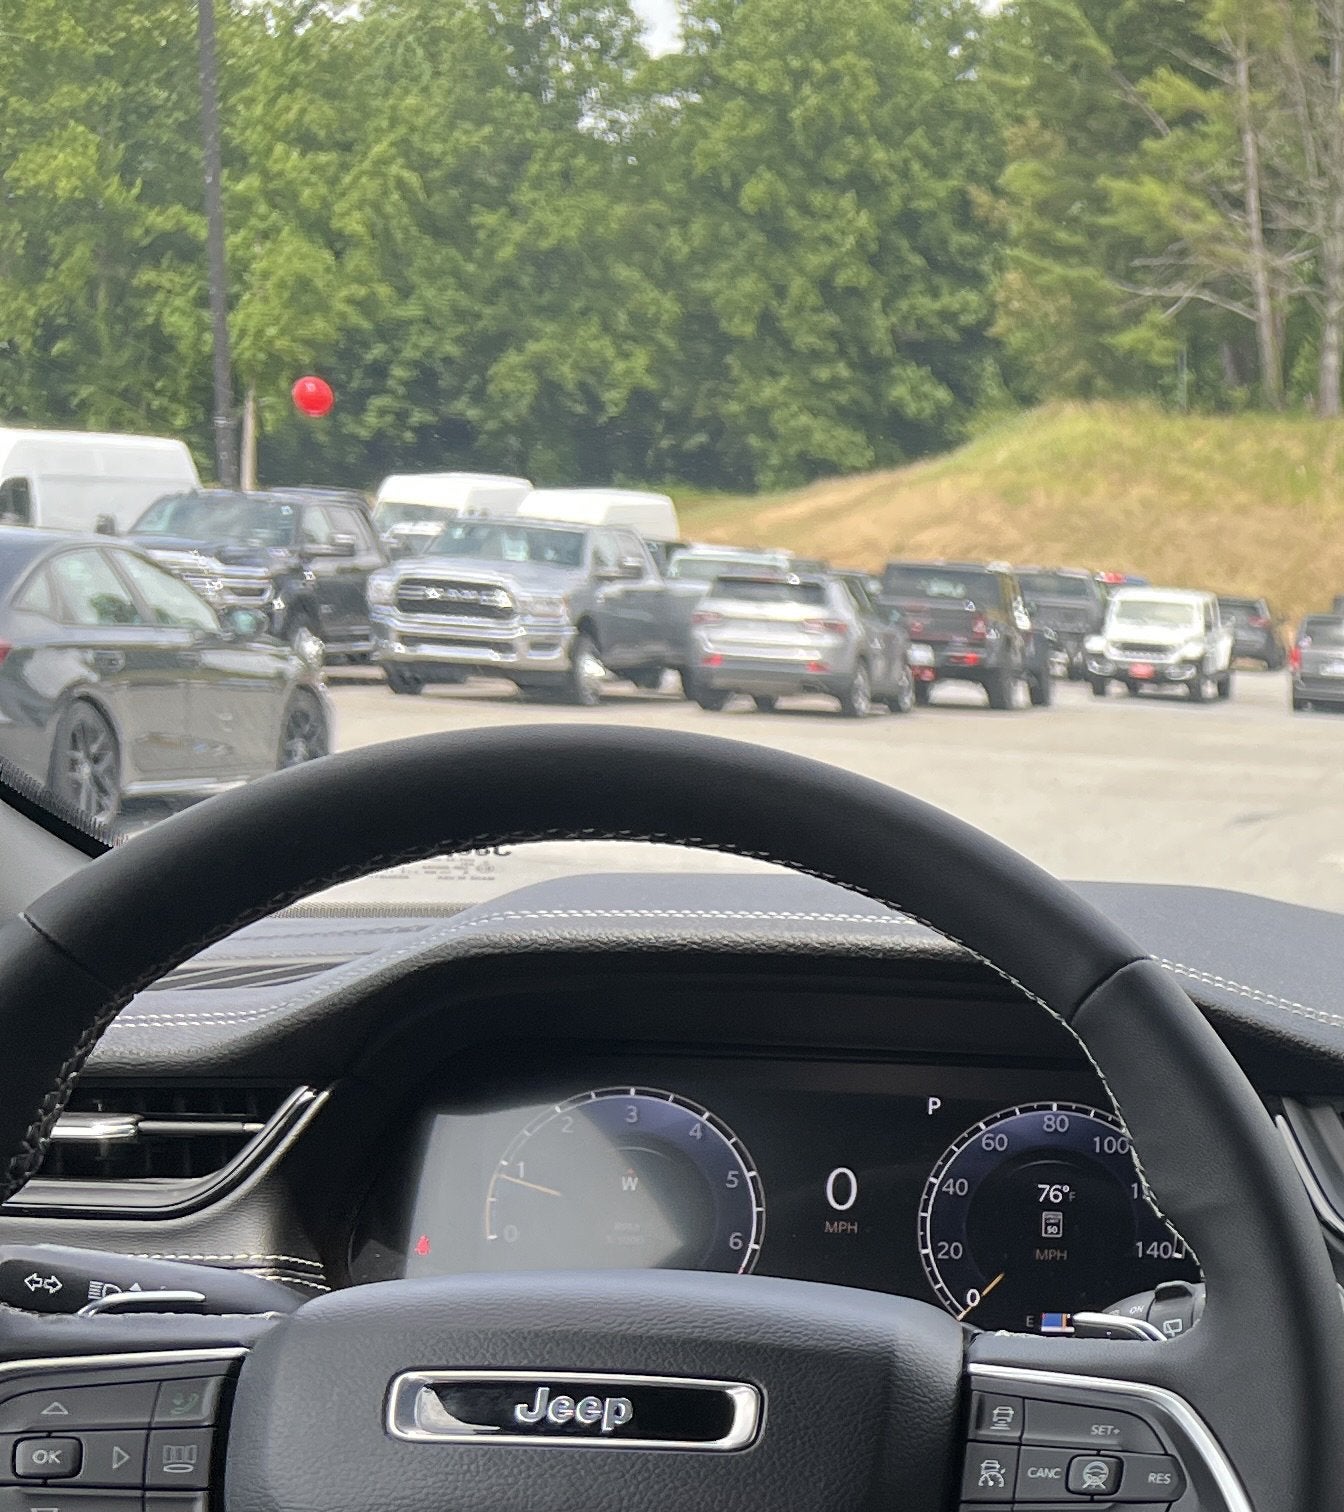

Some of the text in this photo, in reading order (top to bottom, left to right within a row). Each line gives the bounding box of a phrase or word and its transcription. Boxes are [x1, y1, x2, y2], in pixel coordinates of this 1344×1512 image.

[625, 1106, 638, 1123] 3
[927, 1096, 941, 1115] P
[560, 1115, 574, 1133] 2
[688, 1123, 703, 1140] 4
[1042, 1115, 1069, 1133] 80
[981, 1134, 1008, 1152] 60
[1093, 1136, 1130, 1154] 100
[515, 1161, 526, 1179] 1
[621, 1175, 639, 1192] W
[725, 1170, 739, 1189] 5
[826, 1166, 858, 1211] 0
[941, 1177, 968, 1196] 40
[824, 1221, 858, 1235] MPH
[1046, 1225, 1059, 1235] 50
[729, 1231, 744, 1251] 6
[1135, 1241, 1172, 1259] 140
[937, 1241, 963, 1260] 20
[1035, 1248, 1068, 1262] MPH
[966, 1288, 981, 1307] 0
[1129, 1305, 1145, 1314] ON
[1026, 1315, 1034, 1327] E
[515, 1387, 634, 1431] Jeep
[1090, 1424, 1121, 1437] SET+
[32, 1449, 62, 1465] OK
[1027, 1467, 1062, 1479] CANC
[1147, 1473, 1172, 1485] RES
